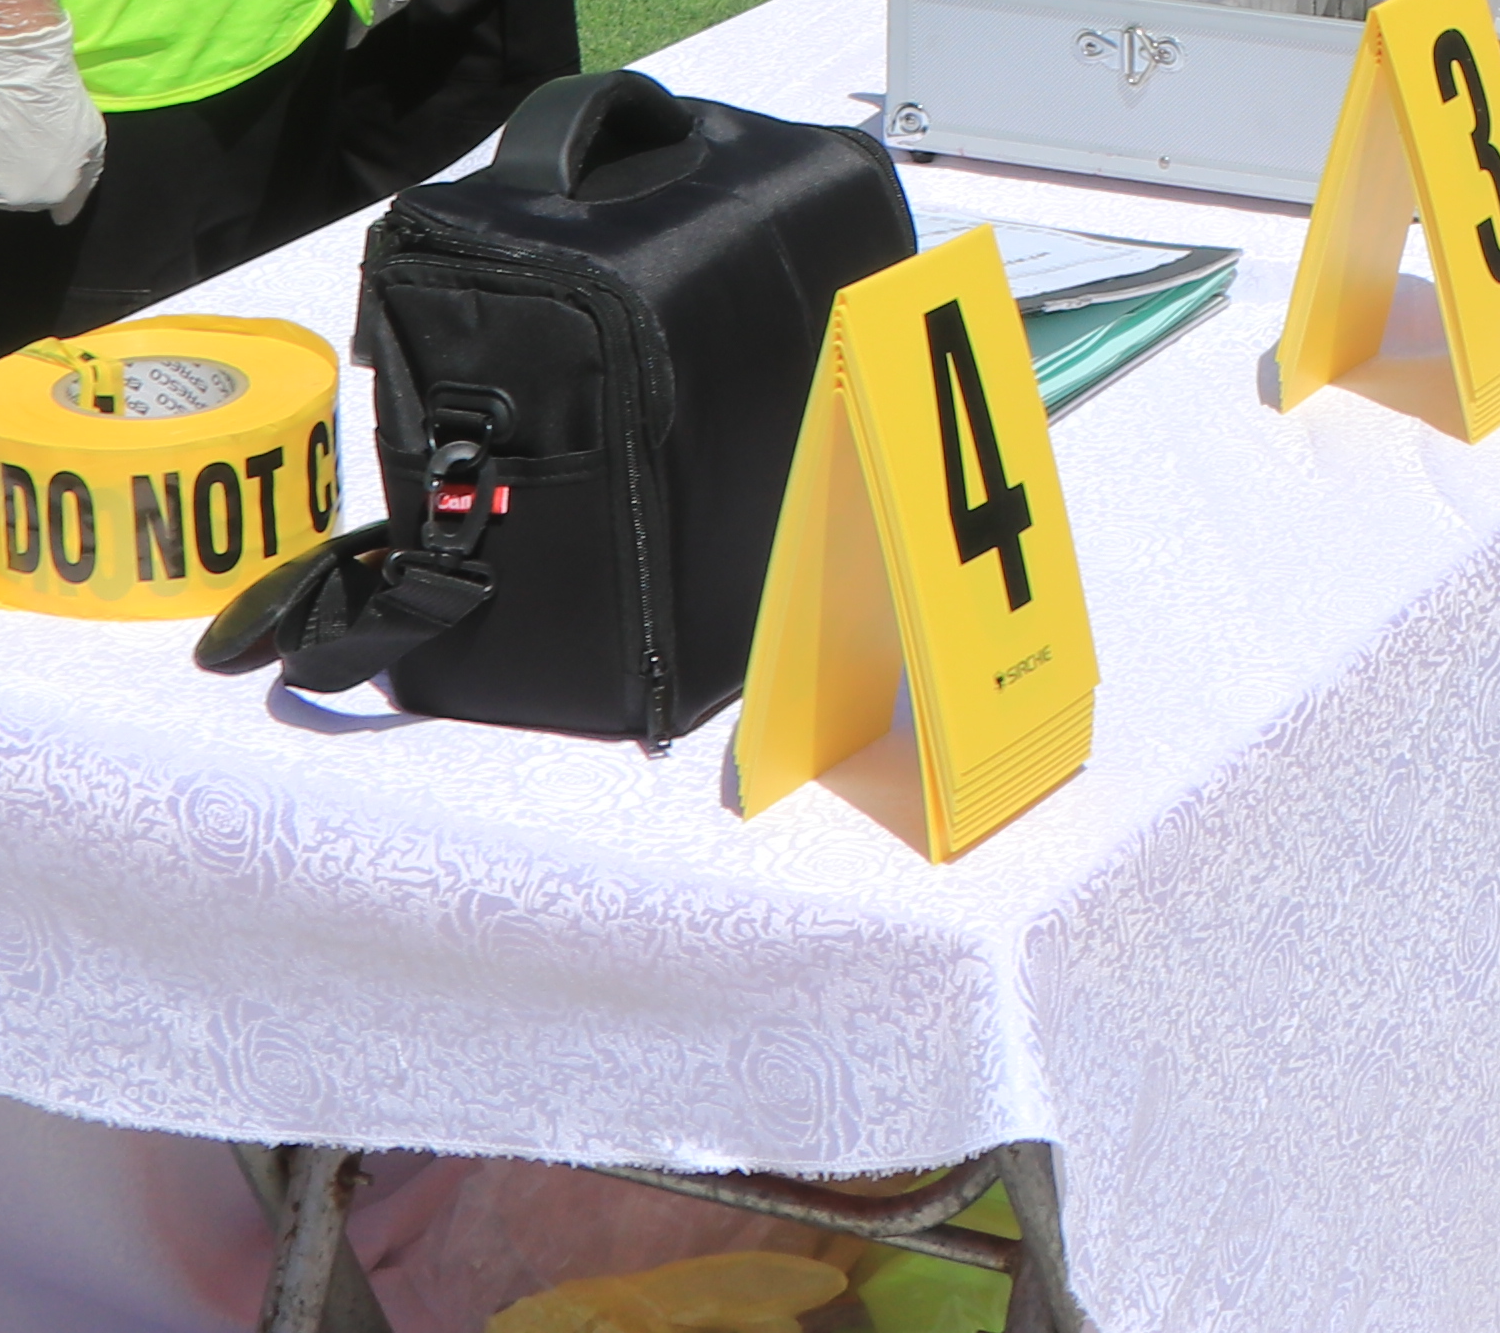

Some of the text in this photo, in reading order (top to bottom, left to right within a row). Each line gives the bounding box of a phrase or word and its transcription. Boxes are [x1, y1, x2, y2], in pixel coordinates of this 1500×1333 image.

[1, 462, 97, 585] DO
[131, 446, 284, 582] NOT
[923, 297, 1033, 613] 4
